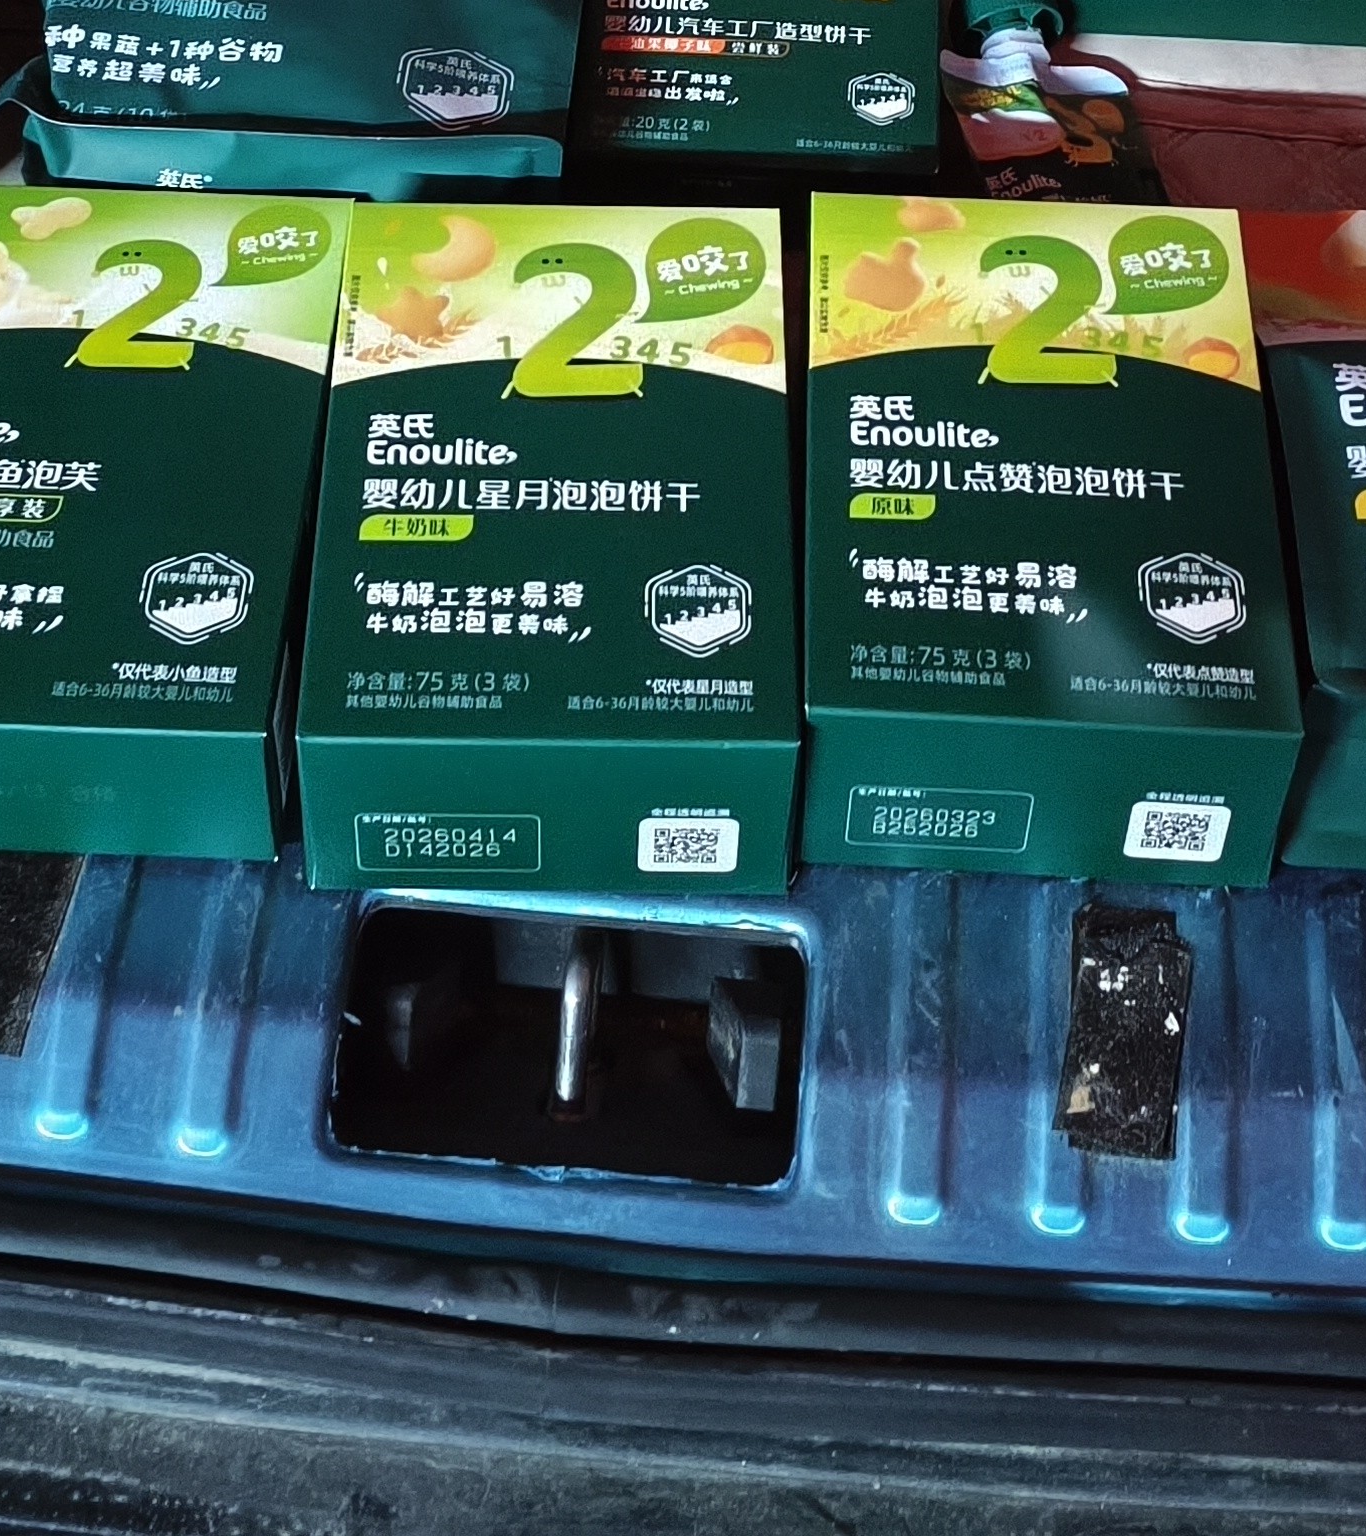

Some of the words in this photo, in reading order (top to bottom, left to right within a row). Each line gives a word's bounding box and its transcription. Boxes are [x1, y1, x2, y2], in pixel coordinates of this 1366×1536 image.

[604, 14, 872, 46] 婴幼儿汽车工厂造型饼干
[51, 52, 203, 85] 营养超美味
[155, 168, 205, 190] 英氏
[237, 225, 320, 256] 爱咬了
[252, 252, 307, 266] Chewing
[655, 244, 752, 282] 爱咬了
[1119, 242, 1212, 277] 爱咬了
[678, 275, 741, 297] Chewing
[1143, 273, 1207, 292] Chewing
[77, 238, 203, 367] 2
[979, 234, 1118, 387] 2
[175, 317, 195, 338] 3
[198, 321, 220, 342] 4
[226, 326, 251, 348] 5
[508, 241, 644, 398] 2
[496, 334, 513, 359] 1
[609, 336, 632, 361] 3
[635, 338, 661, 363] 4
[668, 341, 695, 367] 5
[849, 394, 915, 422] 英氏
[367, 412, 435, 439] 英氏
[849, 421, 995, 449] Enoulite
[366, 438, 513, 466] Enoulite
[849, 457, 1185, 501] 婴幼儿点赞泡泡饼干
[360, 477, 701, 513] 婴幼儿星月泡泡饼干
[870, 496, 916, 516] 原味
[382, 518, 451, 539] 牛奶味
[861, 557, 1079, 591] 酶解工艺好易溶
[366, 580, 585, 608] 酶解工艺好易溶
[863, 584, 1066, 616] 牛奶泡泡更美味
[365, 607, 570, 636] 牛奶泡泡更美味
[50, 680, 235, 704] 适合6-36月龄较大婴儿和幼儿
[344, 693, 503, 711] 其他婴幼儿谷物辅助食品
[566, 694, 755, 713] 适合6-36月龄较大婴儿和幼儿
[874, 805, 997, 826] 20260323
[384, 827, 517, 844] 20260414
[385, 842, 501, 859] D142026
